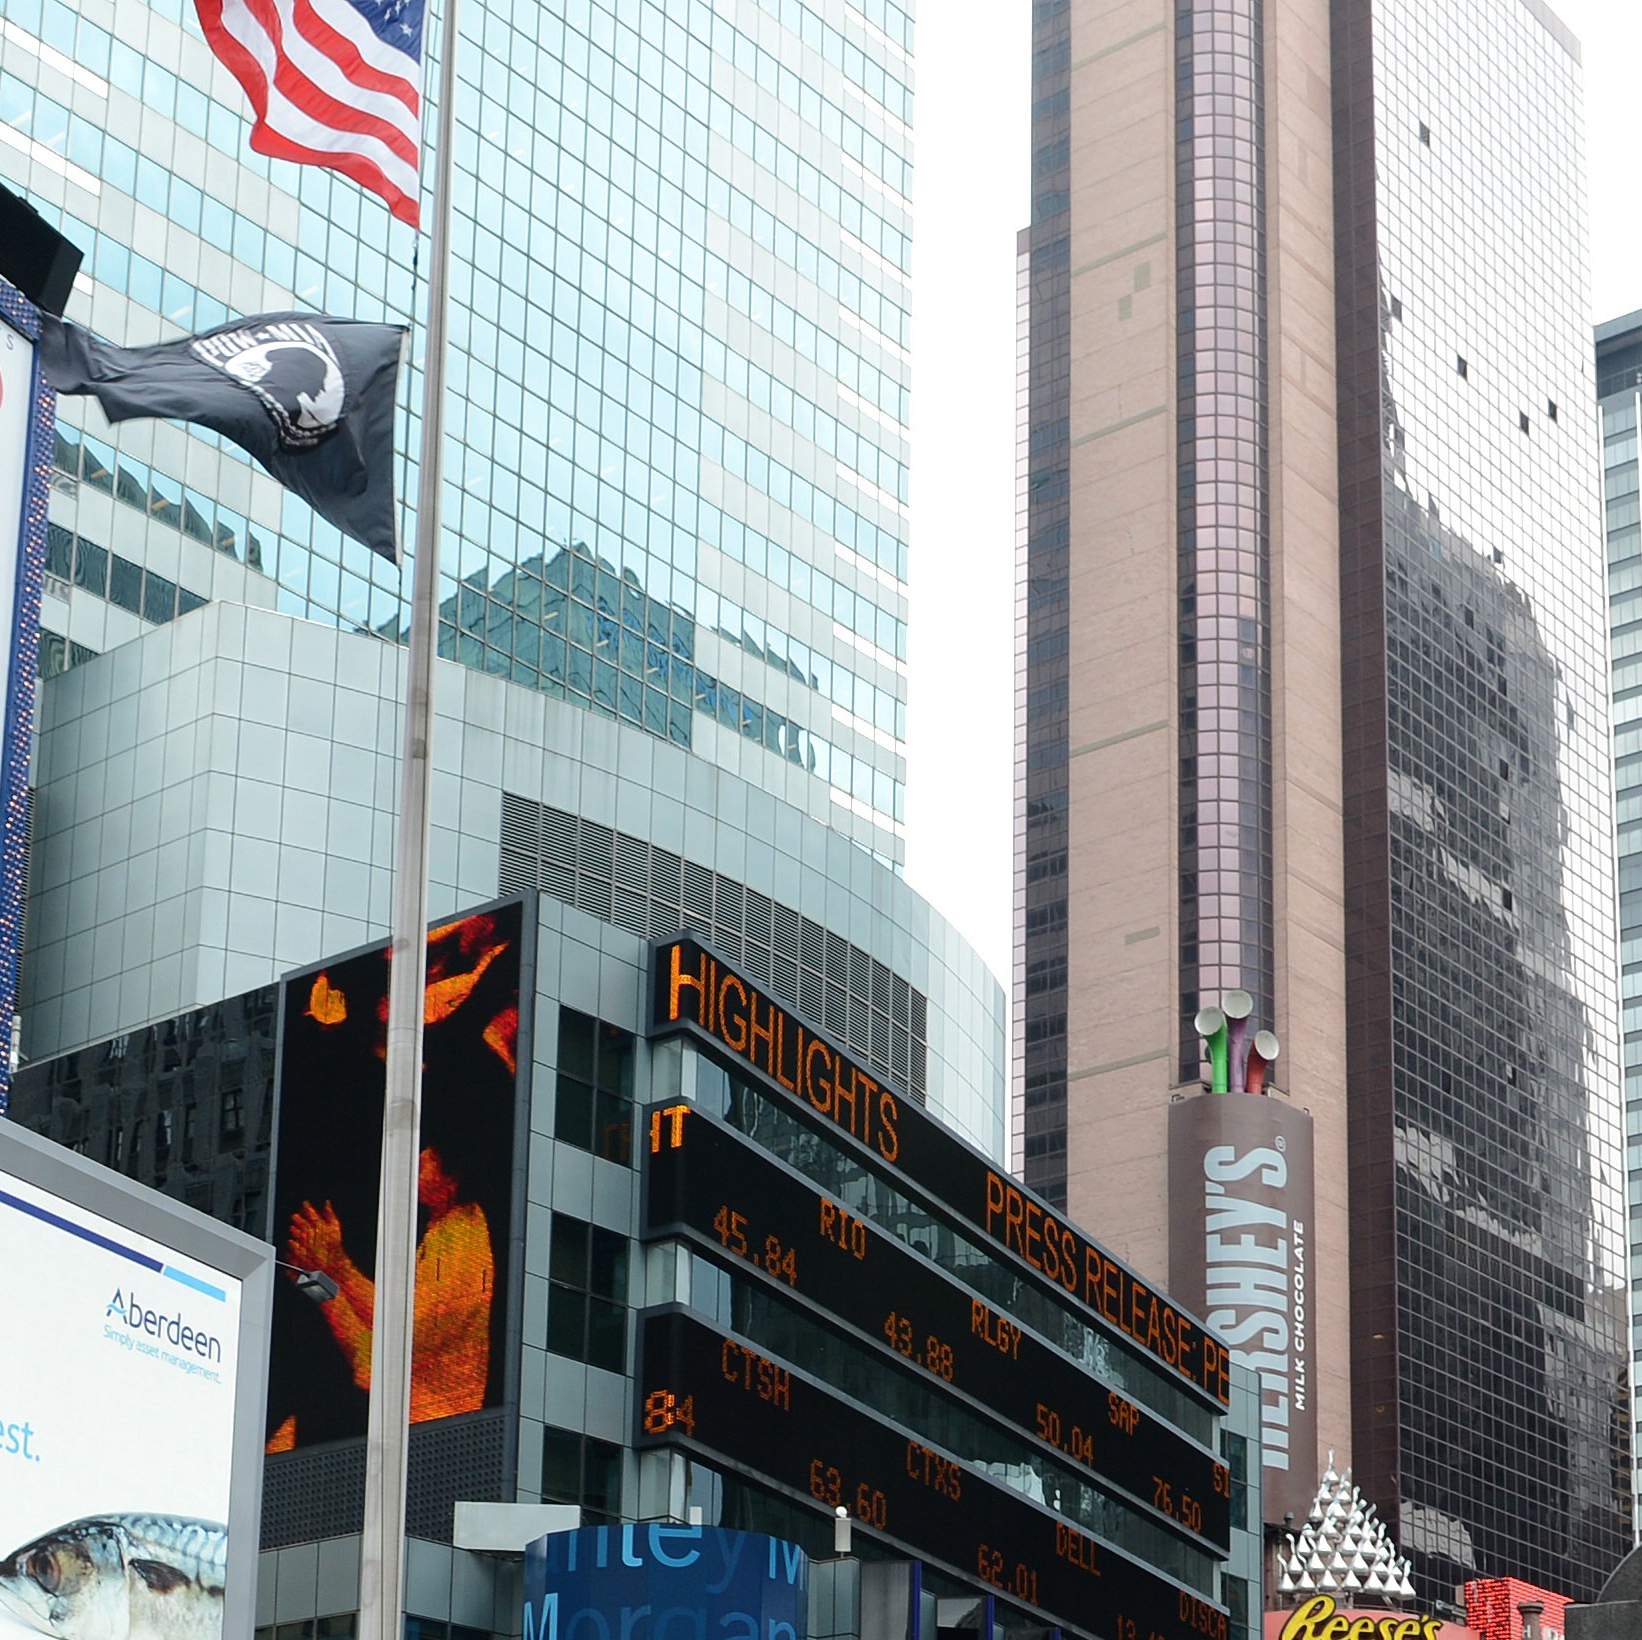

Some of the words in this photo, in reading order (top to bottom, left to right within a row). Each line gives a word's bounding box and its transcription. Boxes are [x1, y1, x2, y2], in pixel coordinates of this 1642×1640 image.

[668, 944, 900, 1165] HIGHLIGHTS
[986, 1171, 1078, 1296] PRESS
[1085, 1246, 1198, 1385] RELEASE:
[103, 1324, 135, 1351] Simply
[106, 1287, 221, 1363] Aberdeen
[712, 1204, 798, 1288] 45.84
[883, 1310, 955, 1384] 43.88
[1035, 1403, 1094, 1469] 50.04
[1293, 1219, 1305, 1352] CHOCOLATE
[970, 1296, 1023, 1361] RLGY
[1107, 1393, 1141, 1436] SAP
[1294, 1357, 1306, 1412] MILK
[721, 1338, 790, 1411] CTSH
[905, 1440, 962, 1501] CTXS
[1057, 1520, 1102, 1578] DELL
[977, 1544, 1039, 1606] 62.01
